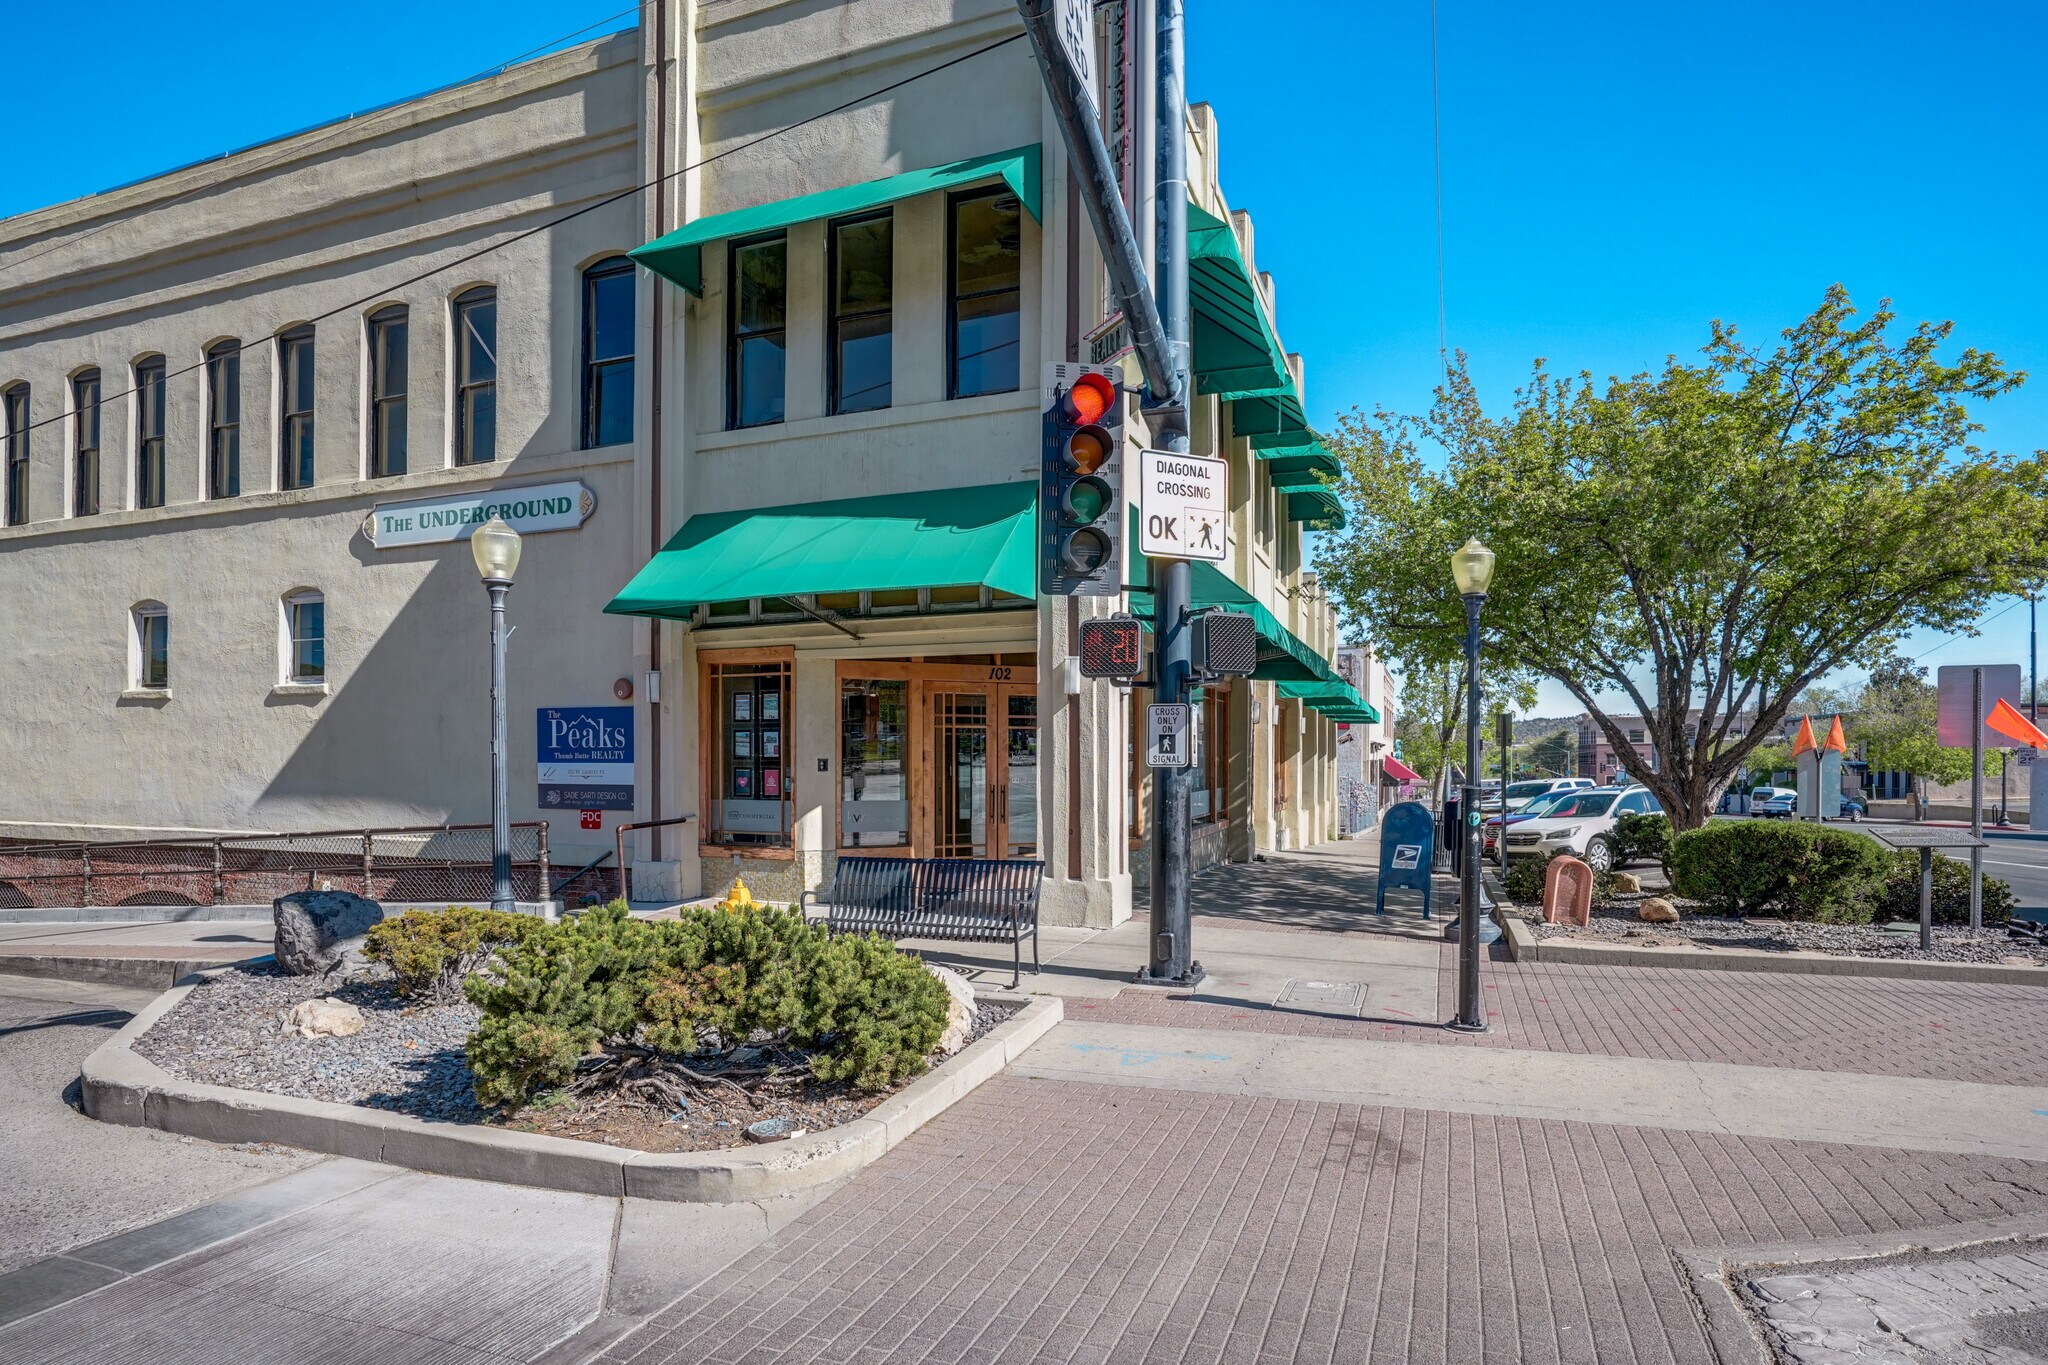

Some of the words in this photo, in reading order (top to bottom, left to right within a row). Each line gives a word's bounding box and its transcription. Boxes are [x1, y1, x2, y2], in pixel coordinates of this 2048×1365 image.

[1065, 15, 1088, 81] RED
[1156, 460, 1211, 480] DIAGONAL
[1157, 481, 1211, 499] CROSSING
[419, 496, 572, 529] UNDERGROUND
[1149, 514, 1178, 541] OK
[988, 667, 1011, 680] 102
[547, 710, 561, 719] The
[1155, 707, 1180, 716] CROSS
[1157, 716, 1178, 725] ONLY
[547, 718, 626, 749] Peaks
[1162, 725, 1173, 733] ON
[554, 752, 574, 760] Thumb
[574, 752, 590, 760] Butte
[591, 750, 625, 760] REALTY
[1153, 755, 1182, 764] SIGNAL
[563, 791, 579, 799] SADIE
[580, 791, 596, 799] SARTI
[597, 791, 617, 800] DESIGN
[581, 811, 601, 822] FDC
